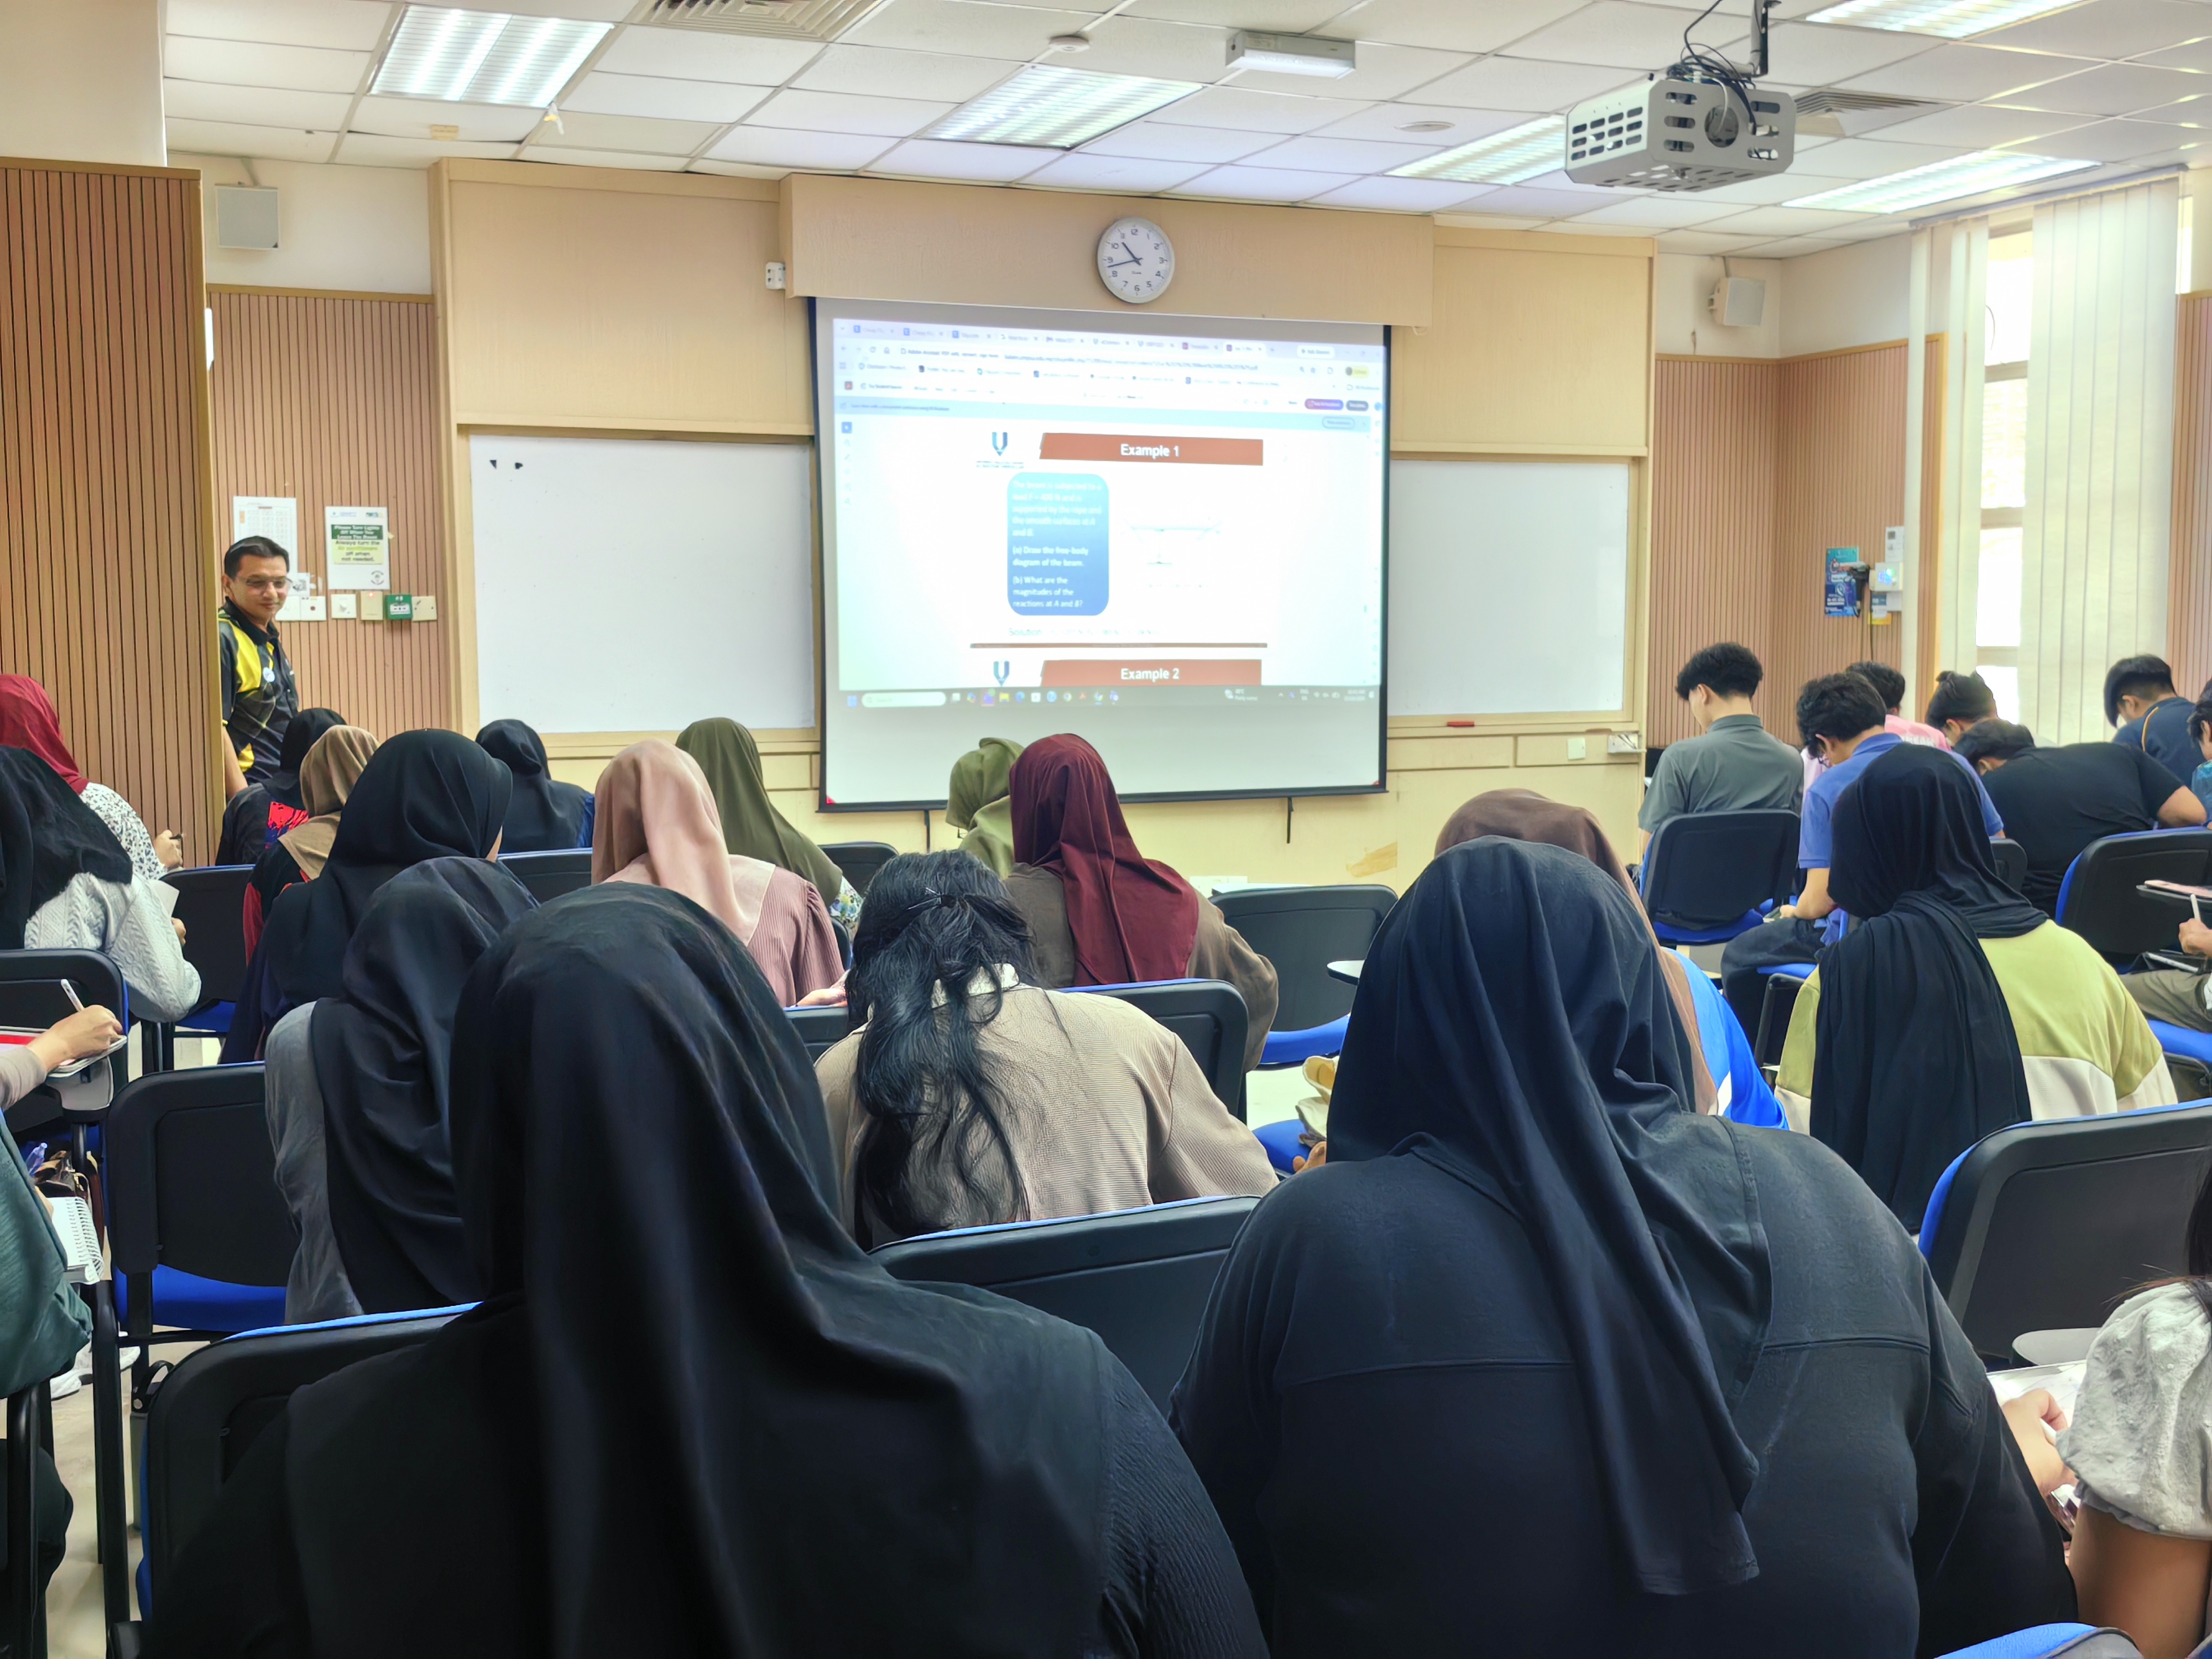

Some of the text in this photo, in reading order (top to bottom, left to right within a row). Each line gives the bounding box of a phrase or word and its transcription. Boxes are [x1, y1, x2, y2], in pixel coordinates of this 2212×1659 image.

[1120, 443, 1180, 459] Example 1
[1012, 546, 1022, 555] (a)
[1012, 557, 1041, 567] diagram
[1013, 576, 1022, 585] (b)
[1024, 576, 1043, 584] What
[1013, 588, 1052, 597] magnitudes
[1120, 667, 1180, 682] Example 2
